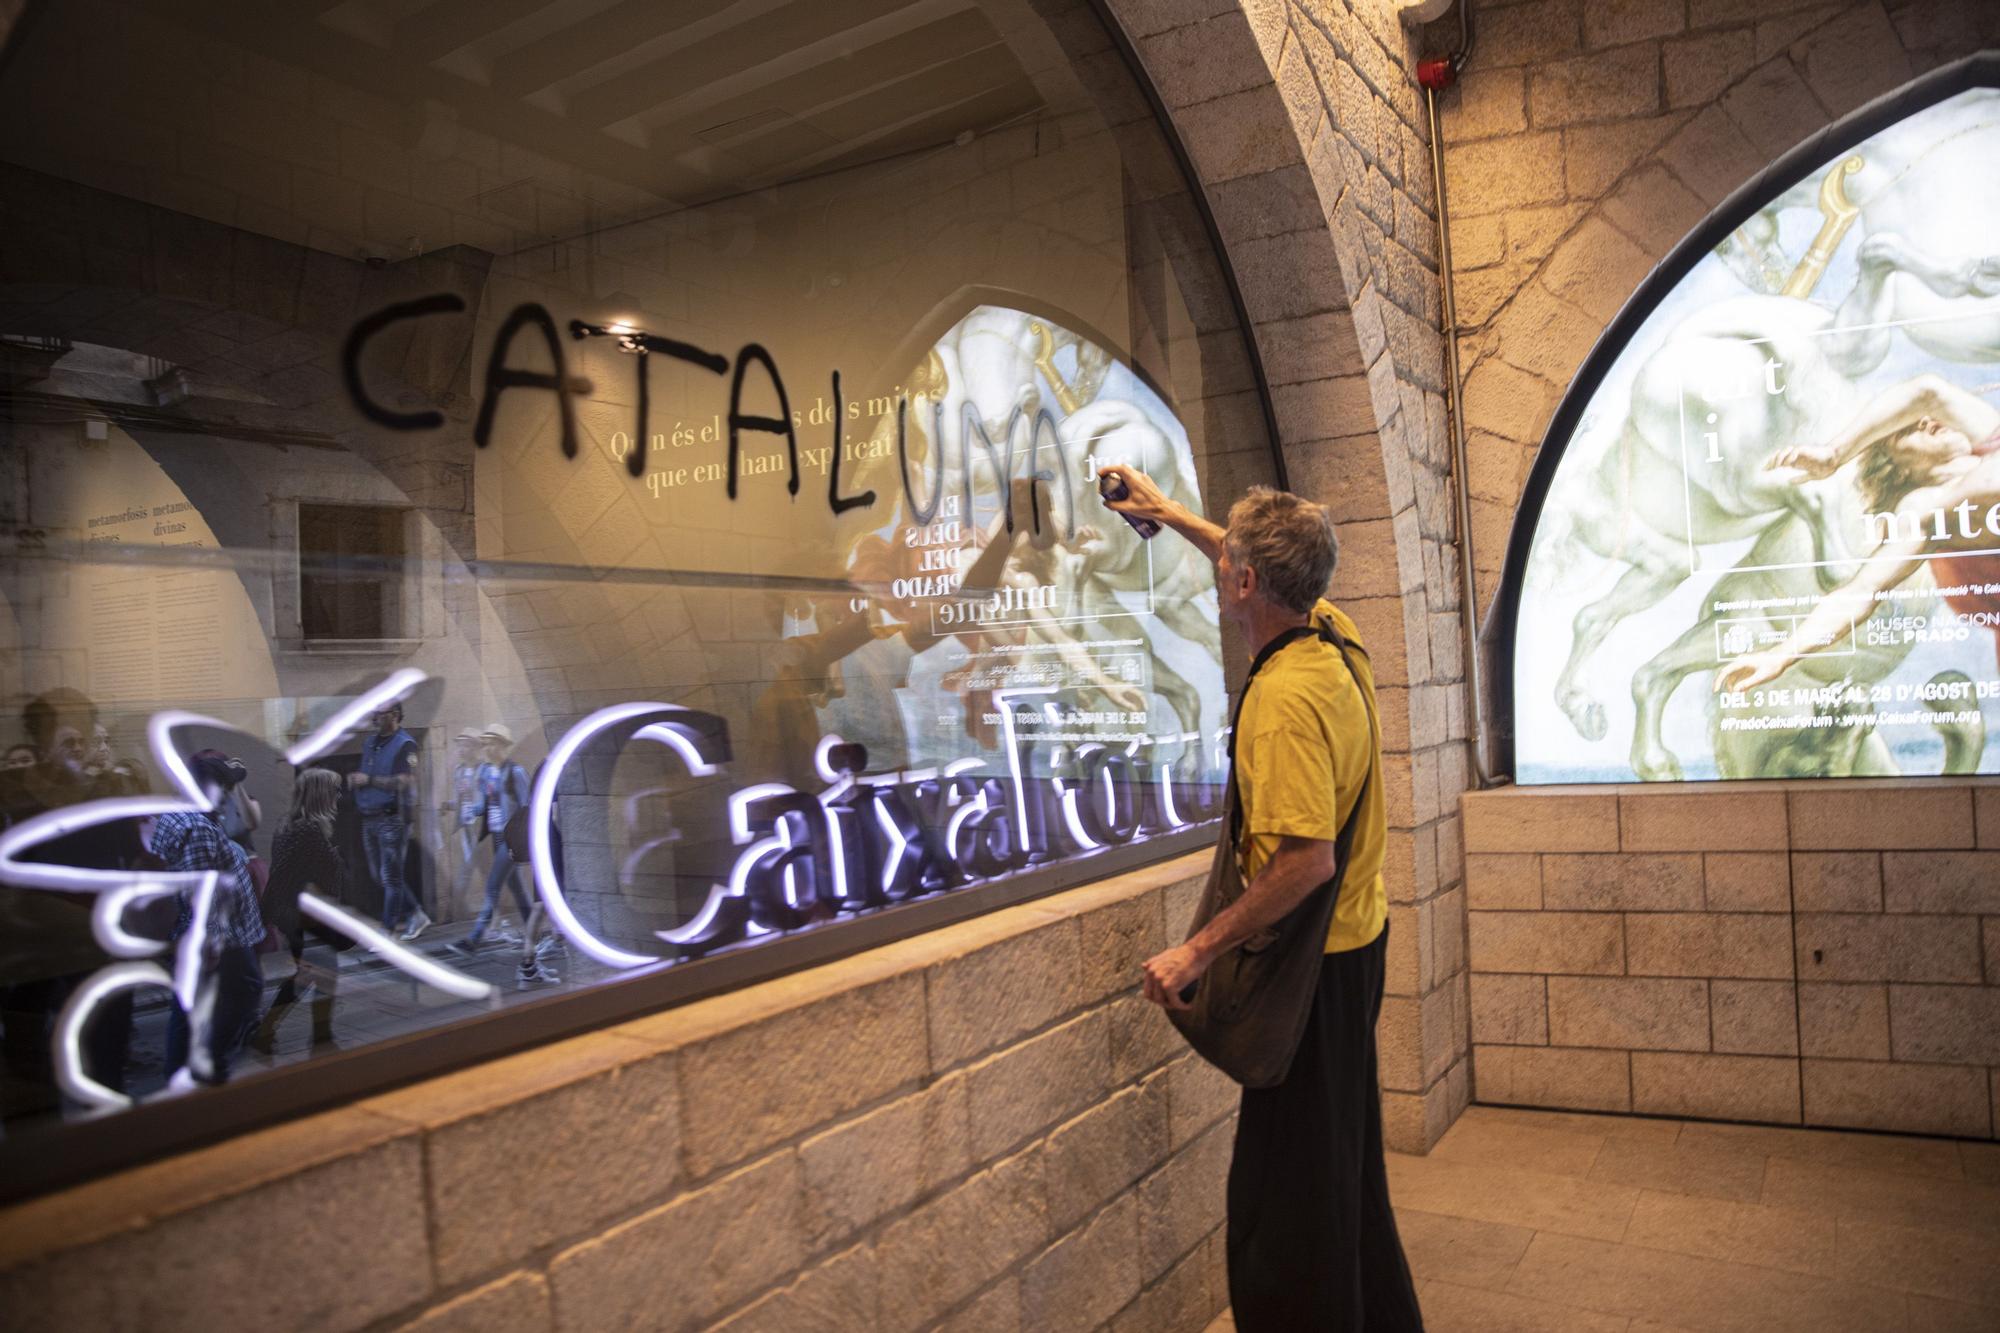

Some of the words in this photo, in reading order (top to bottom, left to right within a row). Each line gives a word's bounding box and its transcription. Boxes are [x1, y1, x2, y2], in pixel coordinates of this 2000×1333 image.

[611, 431, 666, 463] Qn
[671, 421, 694, 448] és
[700, 415, 720, 443] el
[809, 397, 860, 426] des
[646, 468, 688, 499] que
[740, 449, 785, 476] han
[797, 434, 895, 476] xpicat
[153, 520, 187, 537] divinas
[1867, 616, 1927, 632] MUSEO
[1867, 631, 1900, 646] DEL
[1903, 627, 1970, 644] PRADO
[1720, 691, 1751, 709] DEL
[1753, 691, 1765, 708] 3
[1767, 689, 1791, 707] DE
[1794, 686, 1843, 708] MARÇ
[1844, 685, 1867, 704] AL
[1895, 681, 1972, 701] D'AGOST
[1975, 680, 2000, 699] DE
